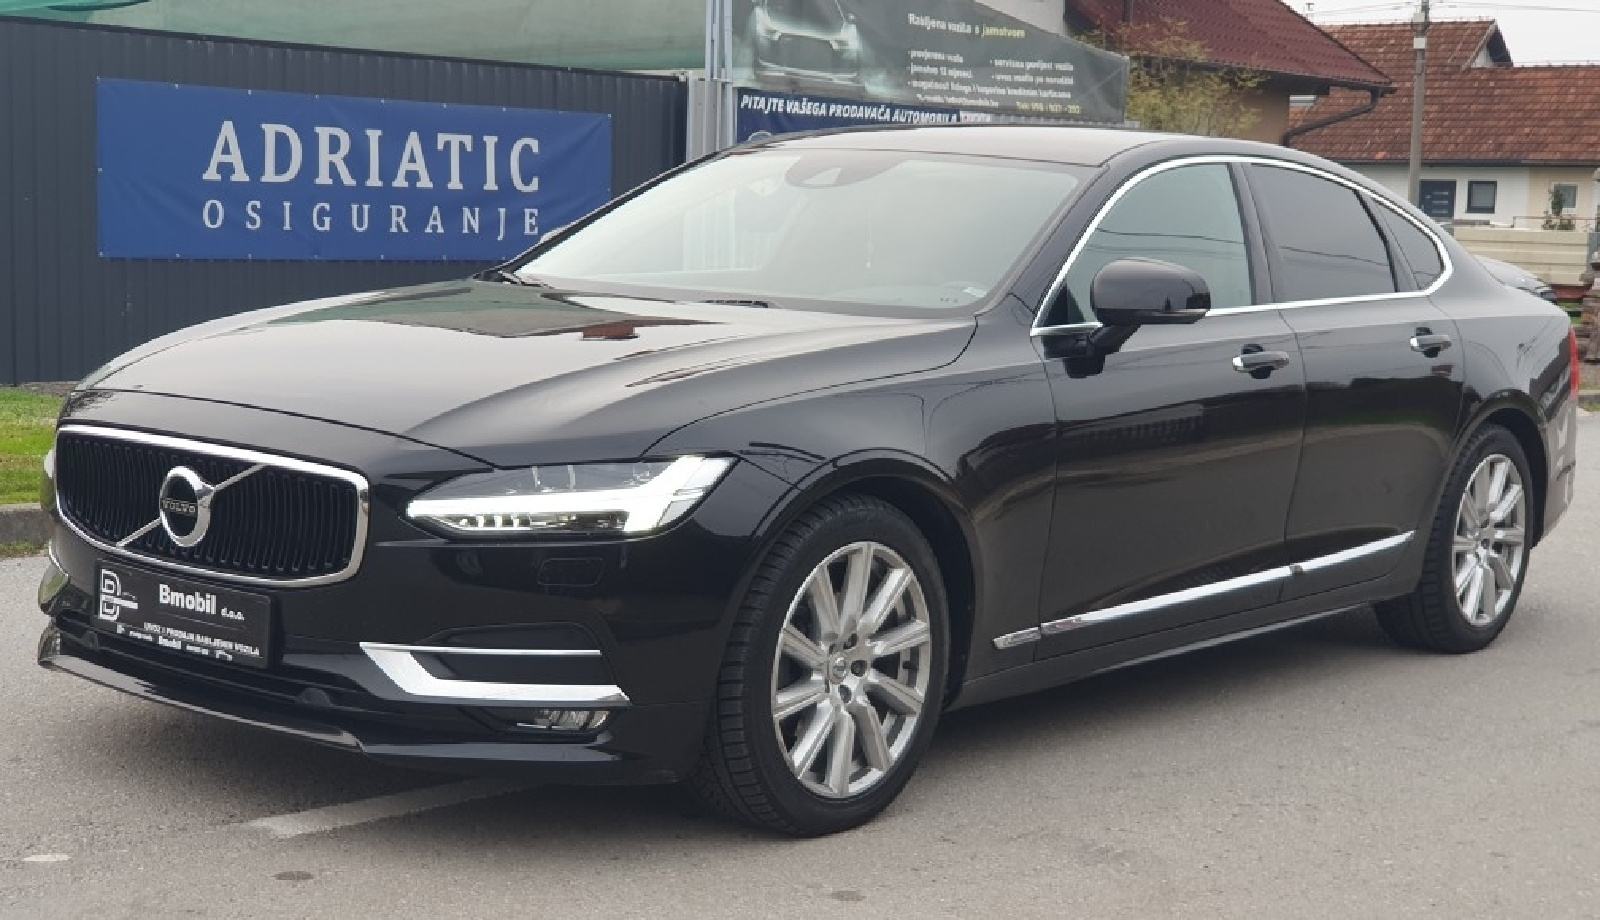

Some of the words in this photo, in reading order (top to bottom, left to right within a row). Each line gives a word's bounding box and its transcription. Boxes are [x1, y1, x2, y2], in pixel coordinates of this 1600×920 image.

[740, 94, 784, 114] PITAJTE
[786, 98, 827, 116] VAŠEGA
[829, 104, 891, 122] PRODAVAČA
[202, 120, 539, 193] ADRIATIC
[202, 199, 539, 241] OSIGURANJE
[161, 500, 196, 513] VOLVO
[159, 583, 217, 615] Bmobil
